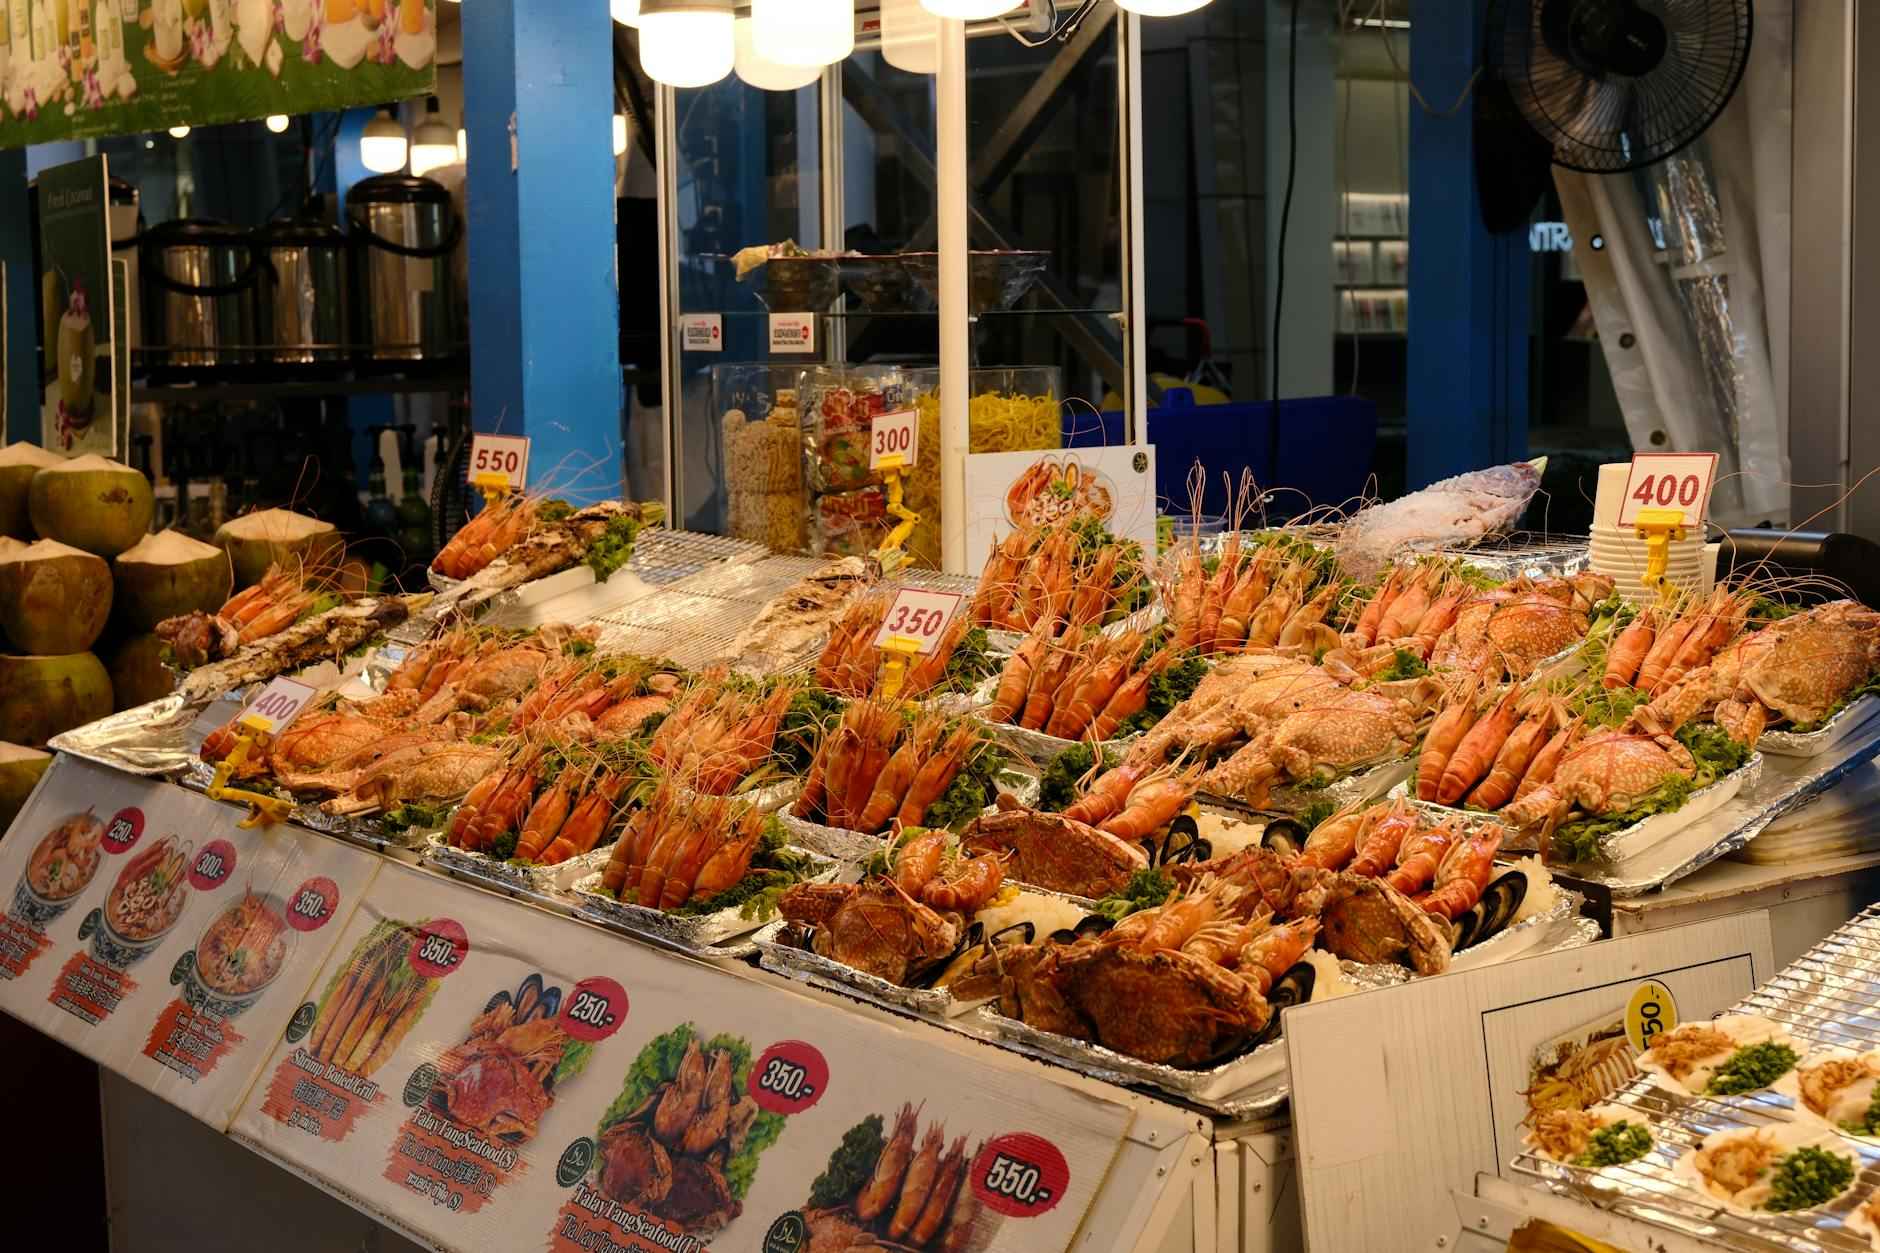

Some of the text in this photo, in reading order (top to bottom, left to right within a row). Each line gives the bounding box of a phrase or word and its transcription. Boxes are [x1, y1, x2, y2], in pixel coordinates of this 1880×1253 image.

[875, 426, 909, 454] 300
[476, 449, 517, 472] 550
[1633, 475, 1699, 506] 400
[889, 606, 943, 636] 350
[256, 692, 298, 720] 400
[570, 993, 614, 1026] 250.-
[293, 1049, 323, 1079] Shrimp
[762, 1061, 813, 1096] 350.-
[987, 1157, 1048, 1202] 550.-
